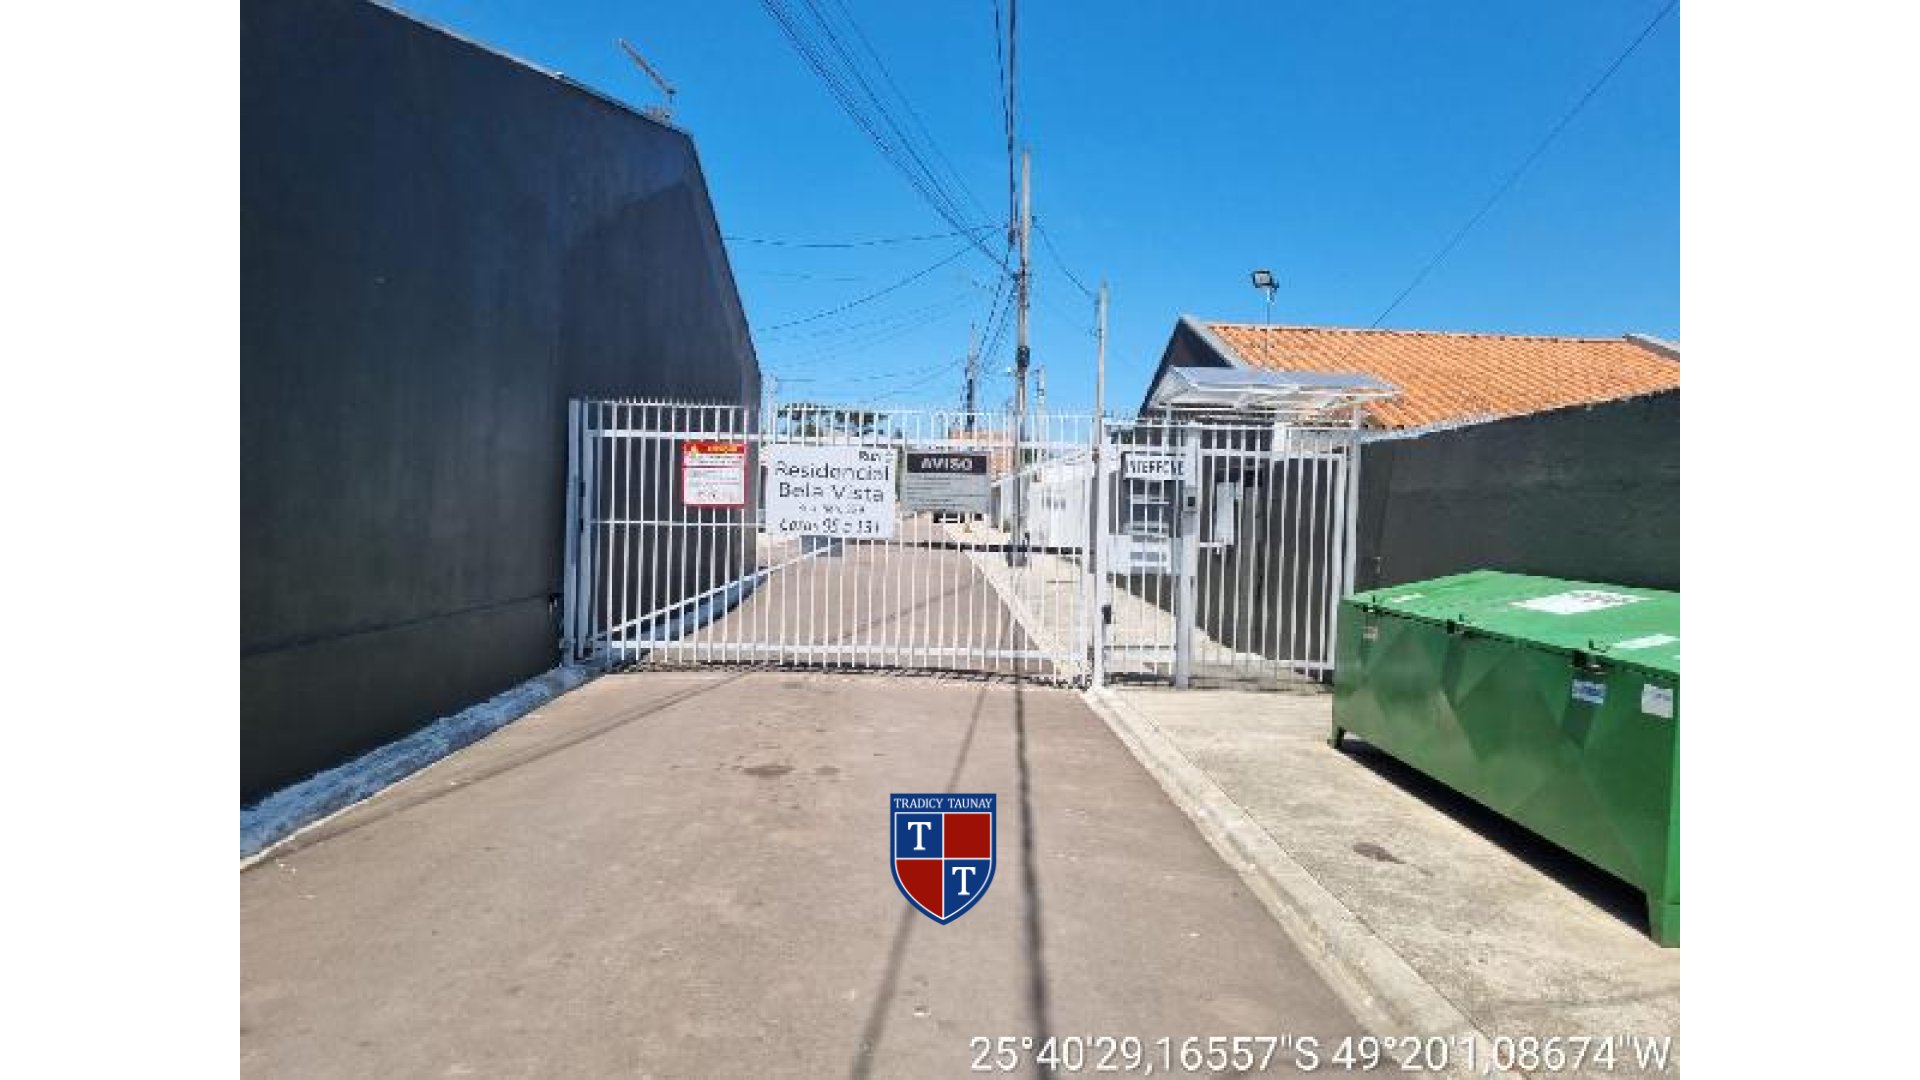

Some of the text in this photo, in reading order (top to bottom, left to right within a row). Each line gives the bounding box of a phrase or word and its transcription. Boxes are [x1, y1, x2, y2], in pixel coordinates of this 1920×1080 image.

[774, 461, 889, 481] Residencial
[921, 457, 973, 471] AVISO
[779, 482, 884, 502] Bela Vista
